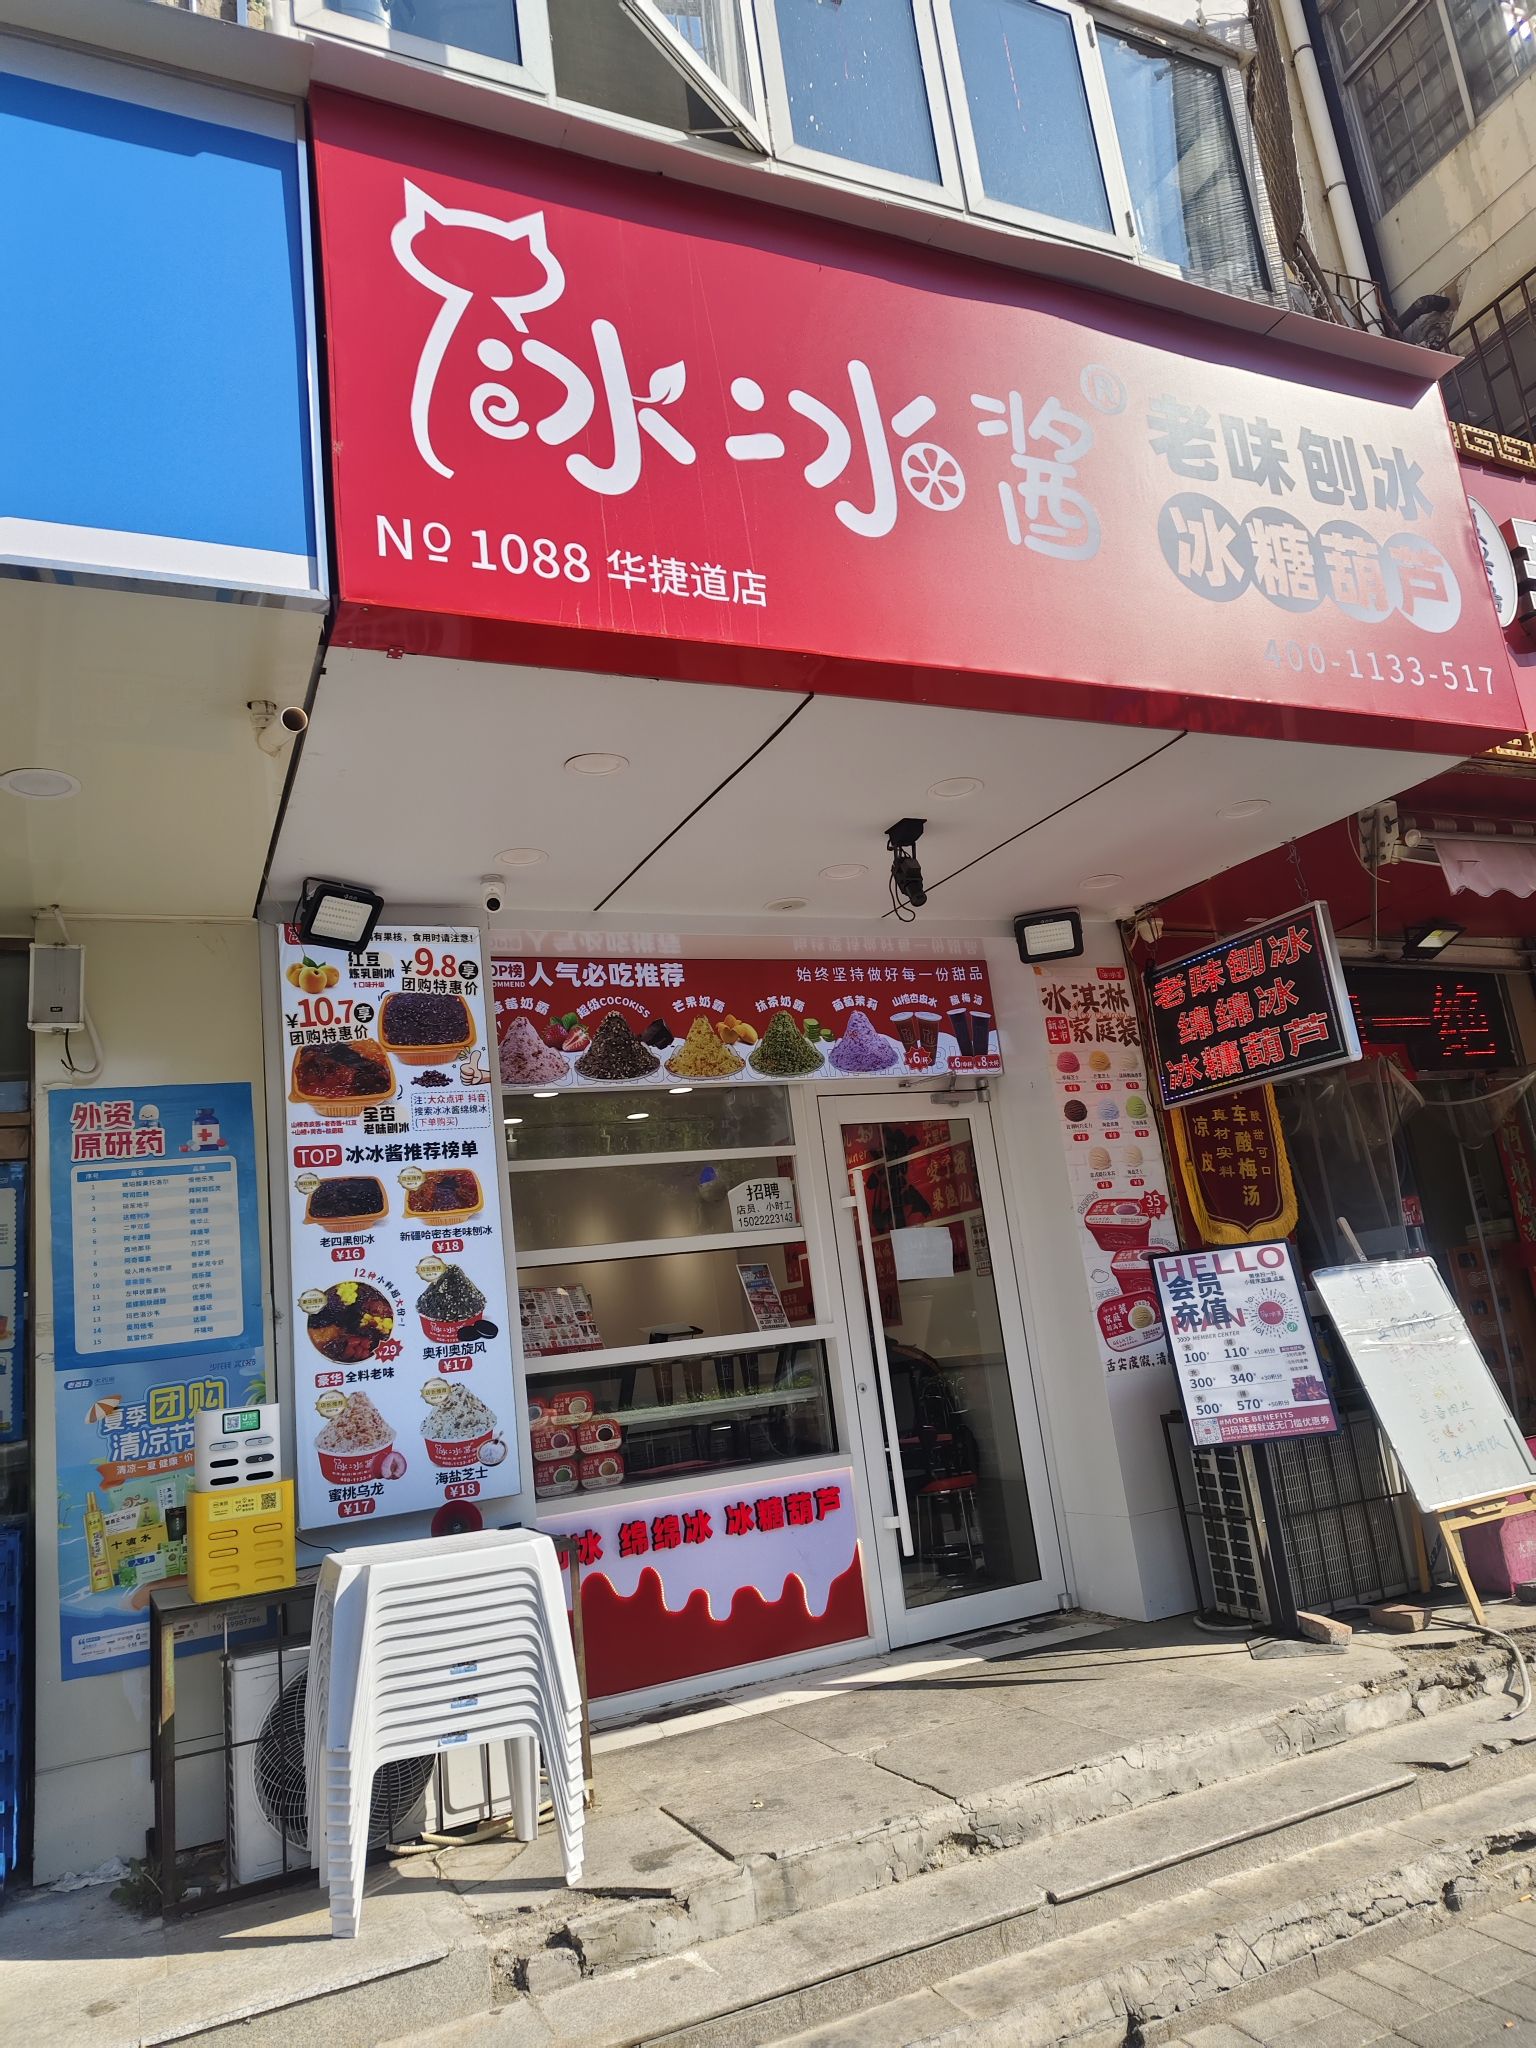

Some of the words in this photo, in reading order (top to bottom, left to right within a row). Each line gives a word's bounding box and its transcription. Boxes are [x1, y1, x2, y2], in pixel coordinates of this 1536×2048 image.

[1147, 394, 1434, 521] 老味刨冰
[470, 528, 590, 583] 1088
[606, 549, 768, 608] 华捷道店
[1174, 505, 1452, 616] 冰糖葫芦
[1263, 638, 1495, 696] 400-1133-517
[348, 952, 381, 967] 红豆
[1153, 925, 1313, 1010] 老味刨冰
[348, 968, 395, 979] 炼乳刨冰
[528, 962, 685, 988] 人气必吃推荐
[796, 966, 983, 983] 始终坚持做好每一份甜品
[401, 977, 478, 995] 团购特惠价
[1041, 982, 1130, 1014] 冰淇淋
[1177, 976, 1299, 1045] 绵绵冰
[289, 1024, 369, 1046] 团购特惠价
[1069, 1016, 1141, 1047] 家庭装
[1165, 1012, 1329, 1090] 冰糖葫芦
[73, 1102, 133, 1129] 外资
[363, 1106, 395, 1122] 全杏
[363, 1122, 410, 1135] 老味刨冰
[73, 1129, 163, 1160] 原研药
[297, 1148, 337, 1165] TOP
[346, 1141, 479, 1164] 冰冰酱推荐榜单
[1193, 1115, 1216, 1173] 凉皮
[1211, 1108, 1235, 1178] 真材实料
[1231, 1091, 1260, 1207] 车酸梅汤
[1249, 1110, 1271, 1175] 酸甜可口
[746, 1182, 780, 1201] 招聘
[1145, 1195, 1161, 1207] 35
[736, 1200, 792, 1215] 店员、小时工
[738, 1212, 793, 1228] 15022223143
[320, 1234, 375, 1247] 老四黑刨冰
[400, 1225, 493, 1242] 新疆哈密杏老味刨冰
[336, 1249, 361, 1260] ¥16
[436, 1241, 460, 1252] ¥18
[1158, 1247, 1285, 1283] HELLO
[1166, 1271, 1225, 1302] 会员
[1172, 1297, 1232, 1327] 充值
[1217, 1330, 1240, 1338] CENTER
[422, 1341, 487, 1359] 奥利奥旋风
[444, 1358, 468, 1371] ¥17
[317, 1373, 343, 1386] 豪华
[345, 1367, 395, 1384] 全料老味
[103, 1404, 147, 1432] 夏季
[149, 1380, 225, 1425] 团购
[1221, 1415, 1330, 1435] 扫码进群就送无门槛优惠券
[1251, 1411, 1294, 1423] BENEFITS
[112, 1421, 195, 1461] 清凉节
[434, 1467, 489, 1485] 海盐芝士
[328, 1482, 385, 1502] 蜜桃乌龙
[450, 1483, 476, 1497] ¥18
[343, 1501, 369, 1514] ¥17
[619, 1509, 713, 1557] 绵绵冰
[725, 1486, 841, 1536] 冰糖葫芦
